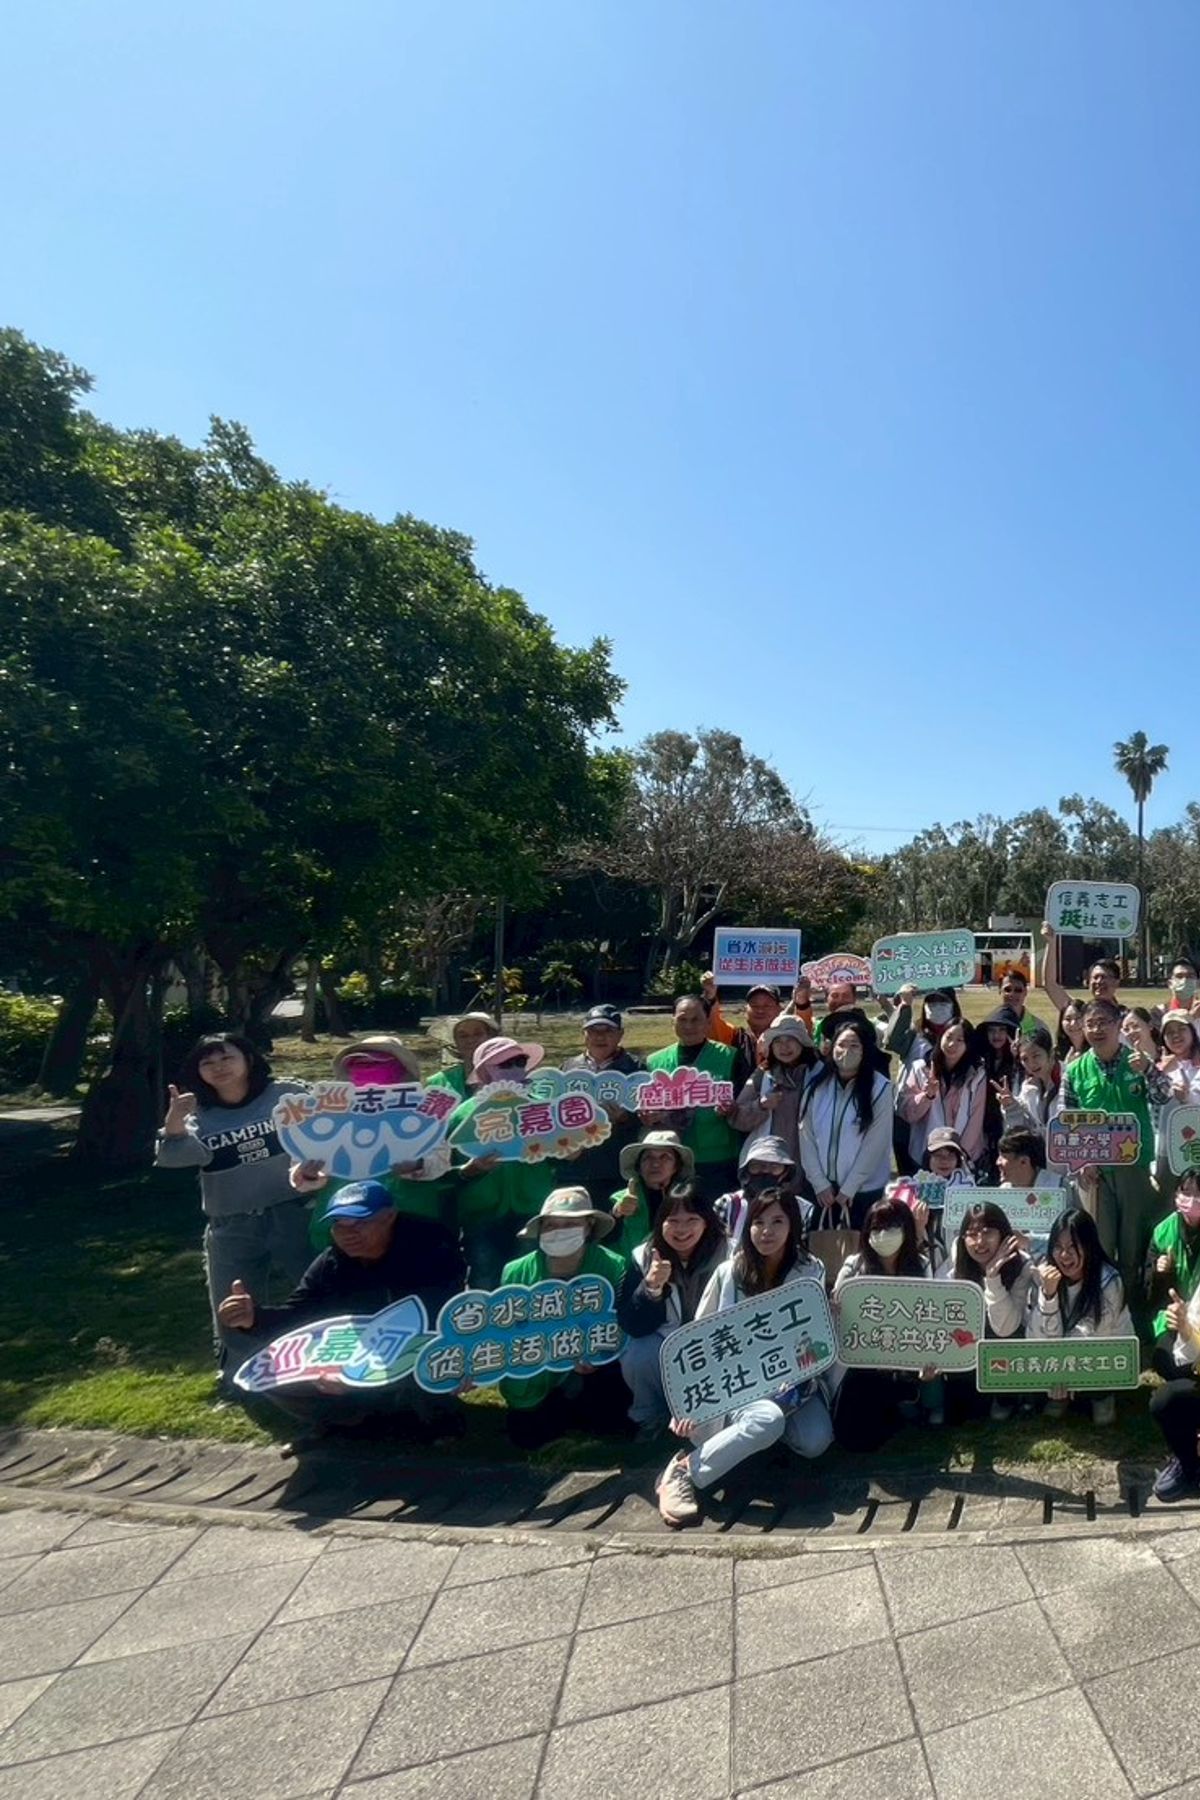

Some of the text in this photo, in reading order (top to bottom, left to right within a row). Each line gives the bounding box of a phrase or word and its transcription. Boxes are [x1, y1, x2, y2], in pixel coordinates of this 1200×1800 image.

[1058, 891, 1128, 909] 信義志工
[1060, 909, 1115, 929] 挺社區
[895, 940, 968, 961] 走入社區
[877, 960, 951, 982] 永續共好
[276, 1086, 457, 1128] 水巡志工讚
[452, 1286, 601, 1334] 省水減污
[859, 1294, 967, 1326] 走入社區
[429, 1320, 620, 1380] 從生活做起
[672, 1299, 812, 1375] 信義志工
[844, 1324, 953, 1355] 永續共好
[245, 1326, 412, 1388] 巡嘉河
[1009, 1355, 1127, 1374] 信義房屋志工日
[682, 1347, 793, 1414] 挺社區
